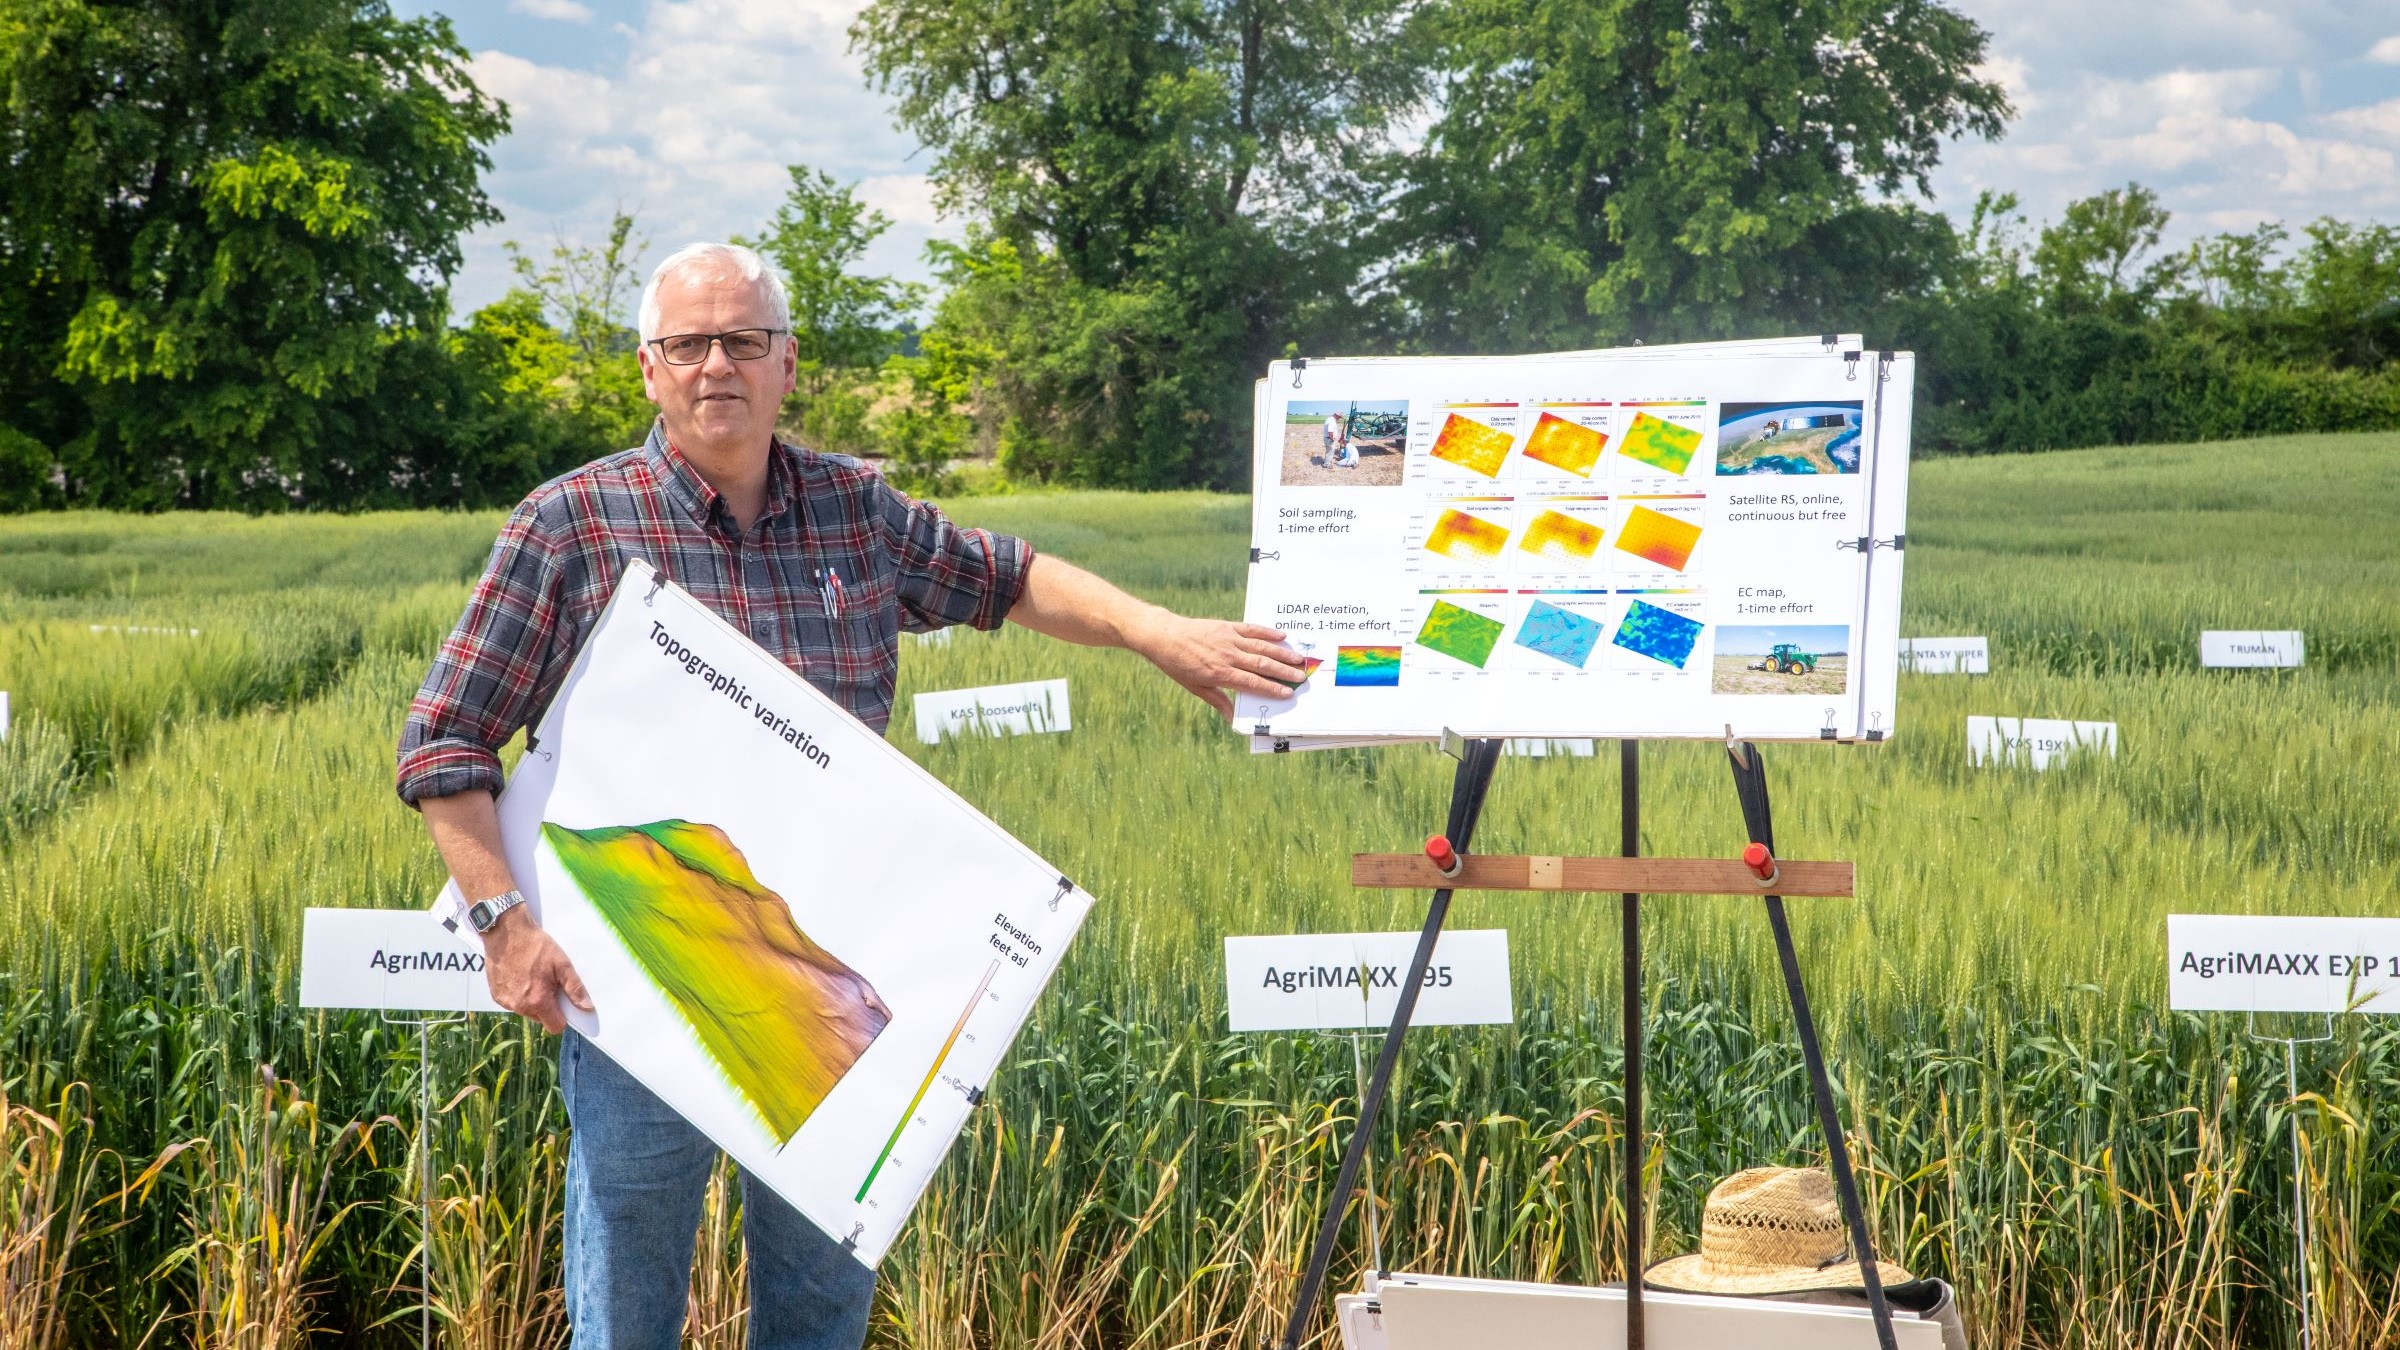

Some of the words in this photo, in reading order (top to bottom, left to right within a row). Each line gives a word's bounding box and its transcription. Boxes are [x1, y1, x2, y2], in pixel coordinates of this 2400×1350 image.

[1729, 494, 1777, 505] Satellite
[1781, 494, 1798, 506] RS,
[1802, 494, 1843, 505] online,
[1279, 508, 1300, 518] Soil
[1302, 508, 1357, 520] sampling,
[1728, 510, 1795, 522] continuous
[1798, 510, 1818, 520] but
[1822, 510, 1846, 520] free
[1278, 524, 1315, 533] 1-time
[1318, 523, 1350, 533] effort
[1738, 588, 1753, 597] EC
[1756, 588, 1786, 598] map,
[1277, 604, 1310, 614] LiDAR
[1313, 604, 1369, 616] elevation,
[1737, 604, 1776, 614] 1-time
[1780, 602, 1814, 613] effort
[1275, 620, 1314, 631] online,
[1318, 620, 1356, 630] 1-time
[1358, 620, 1391, 630] effort
[2230, 644, 2275, 654] TRUMAN
[649, 620, 753, 709] Topographic
[754, 702, 830, 769] variation
[951, 708, 974, 720] KAS
[994, 912, 1042, 956] Elevation
[989, 933, 1012, 954] feet
[1010, 950, 1028, 968] asl
[2180, 951, 2320, 978] AgriMAXX
[2329, 955, 2378, 977] EXP
[1263, 966, 1398, 993] AgriMAXX
[1422, 966, 1452, 988] 95
